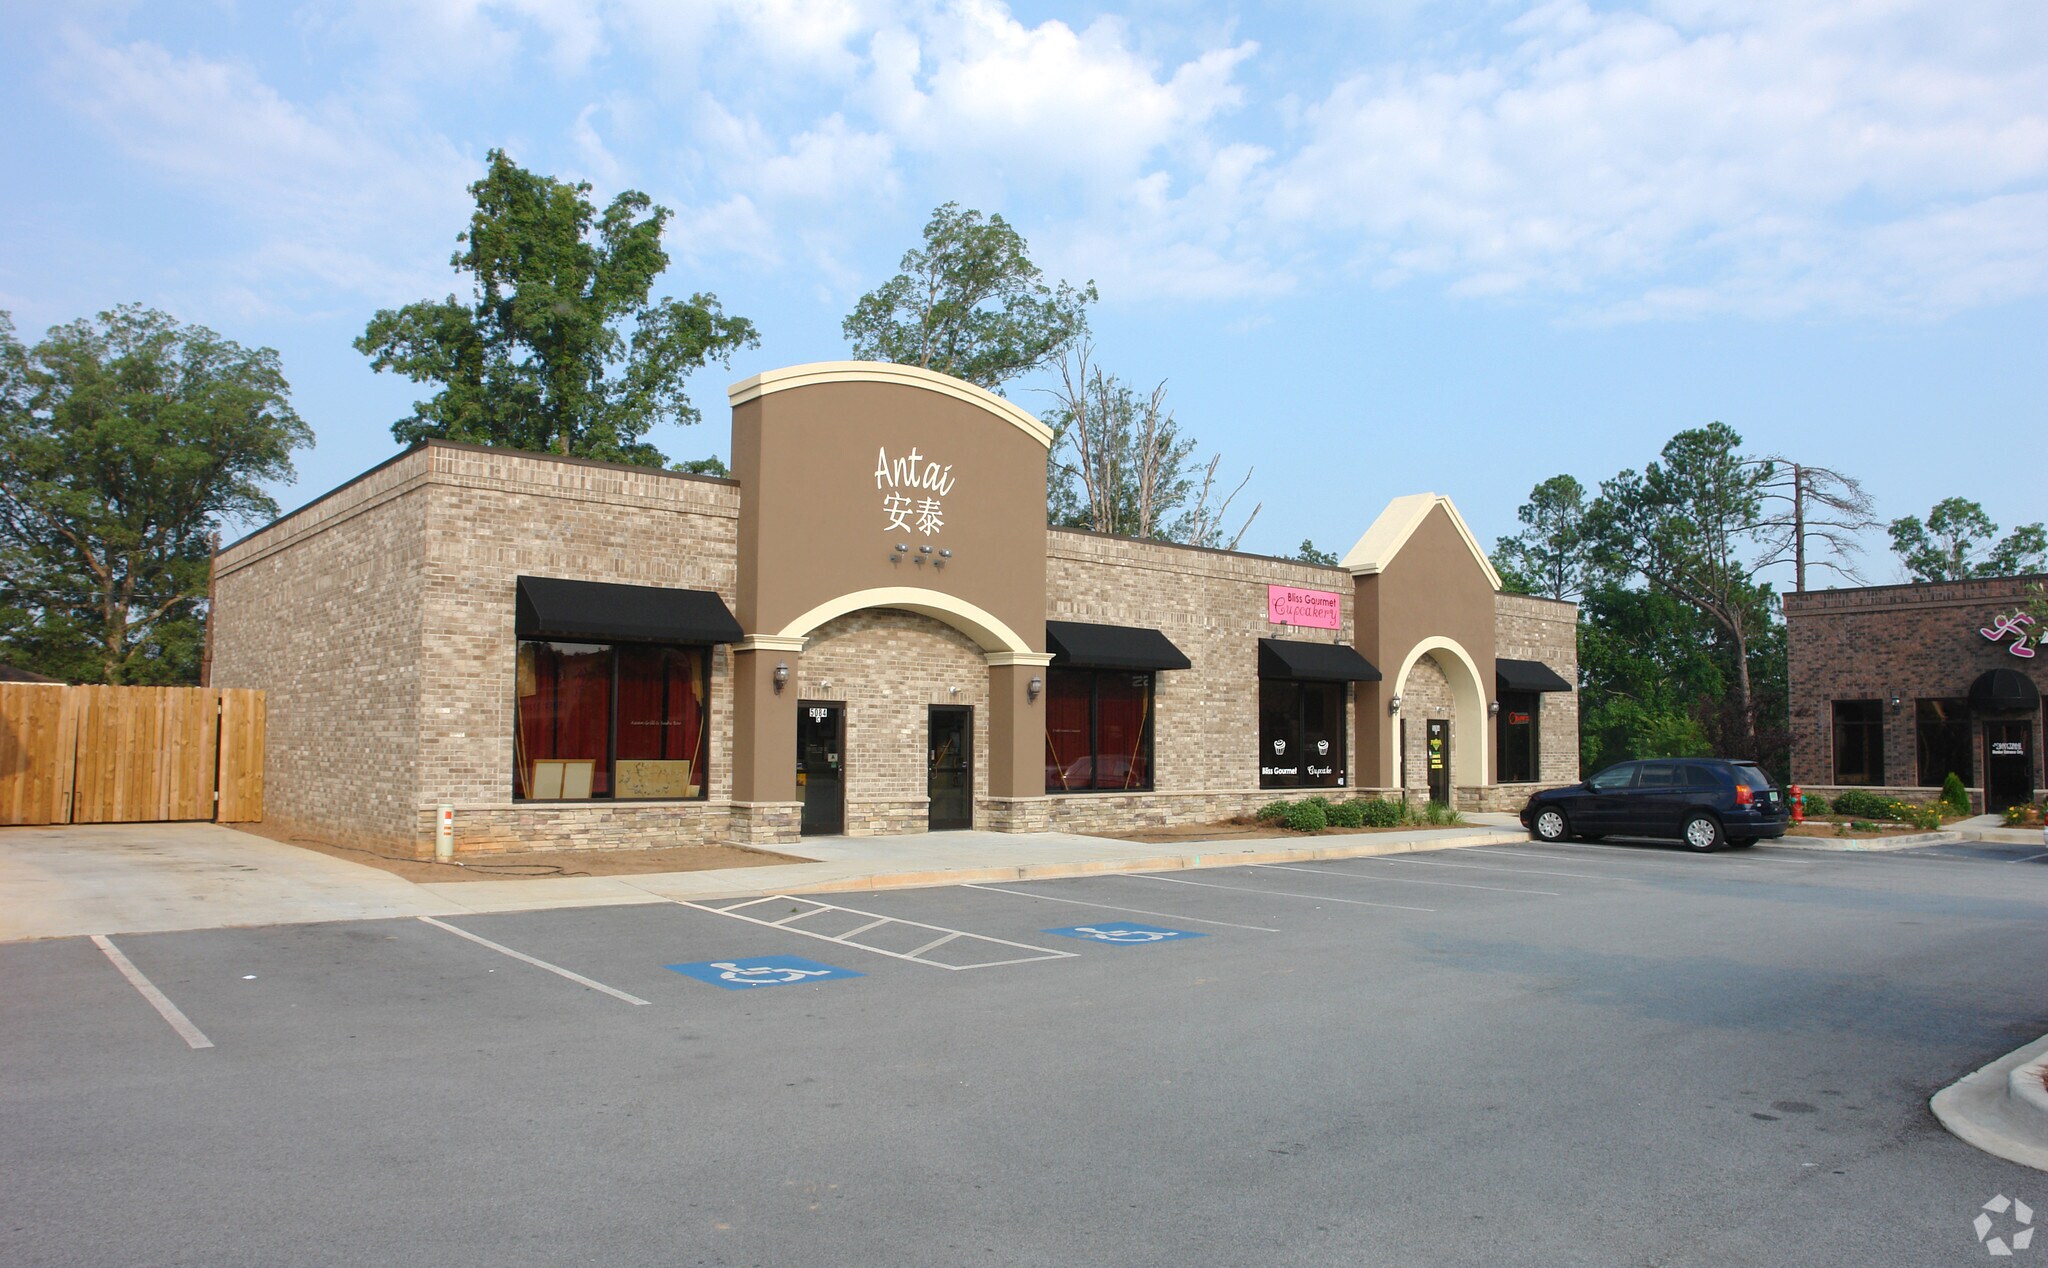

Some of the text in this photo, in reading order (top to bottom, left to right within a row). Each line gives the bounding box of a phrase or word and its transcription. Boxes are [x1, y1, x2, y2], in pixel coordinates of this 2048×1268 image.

[875, 446, 955, 496] Antai
[883, 491, 944, 536] 安泰
[1272, 596, 1337, 626] Cupcakery
[1287, 593, 1337, 607] Bliss Gourmet
[1262, 766, 1273, 775] Bliss
[1274, 766, 1298, 775] Gourmet
